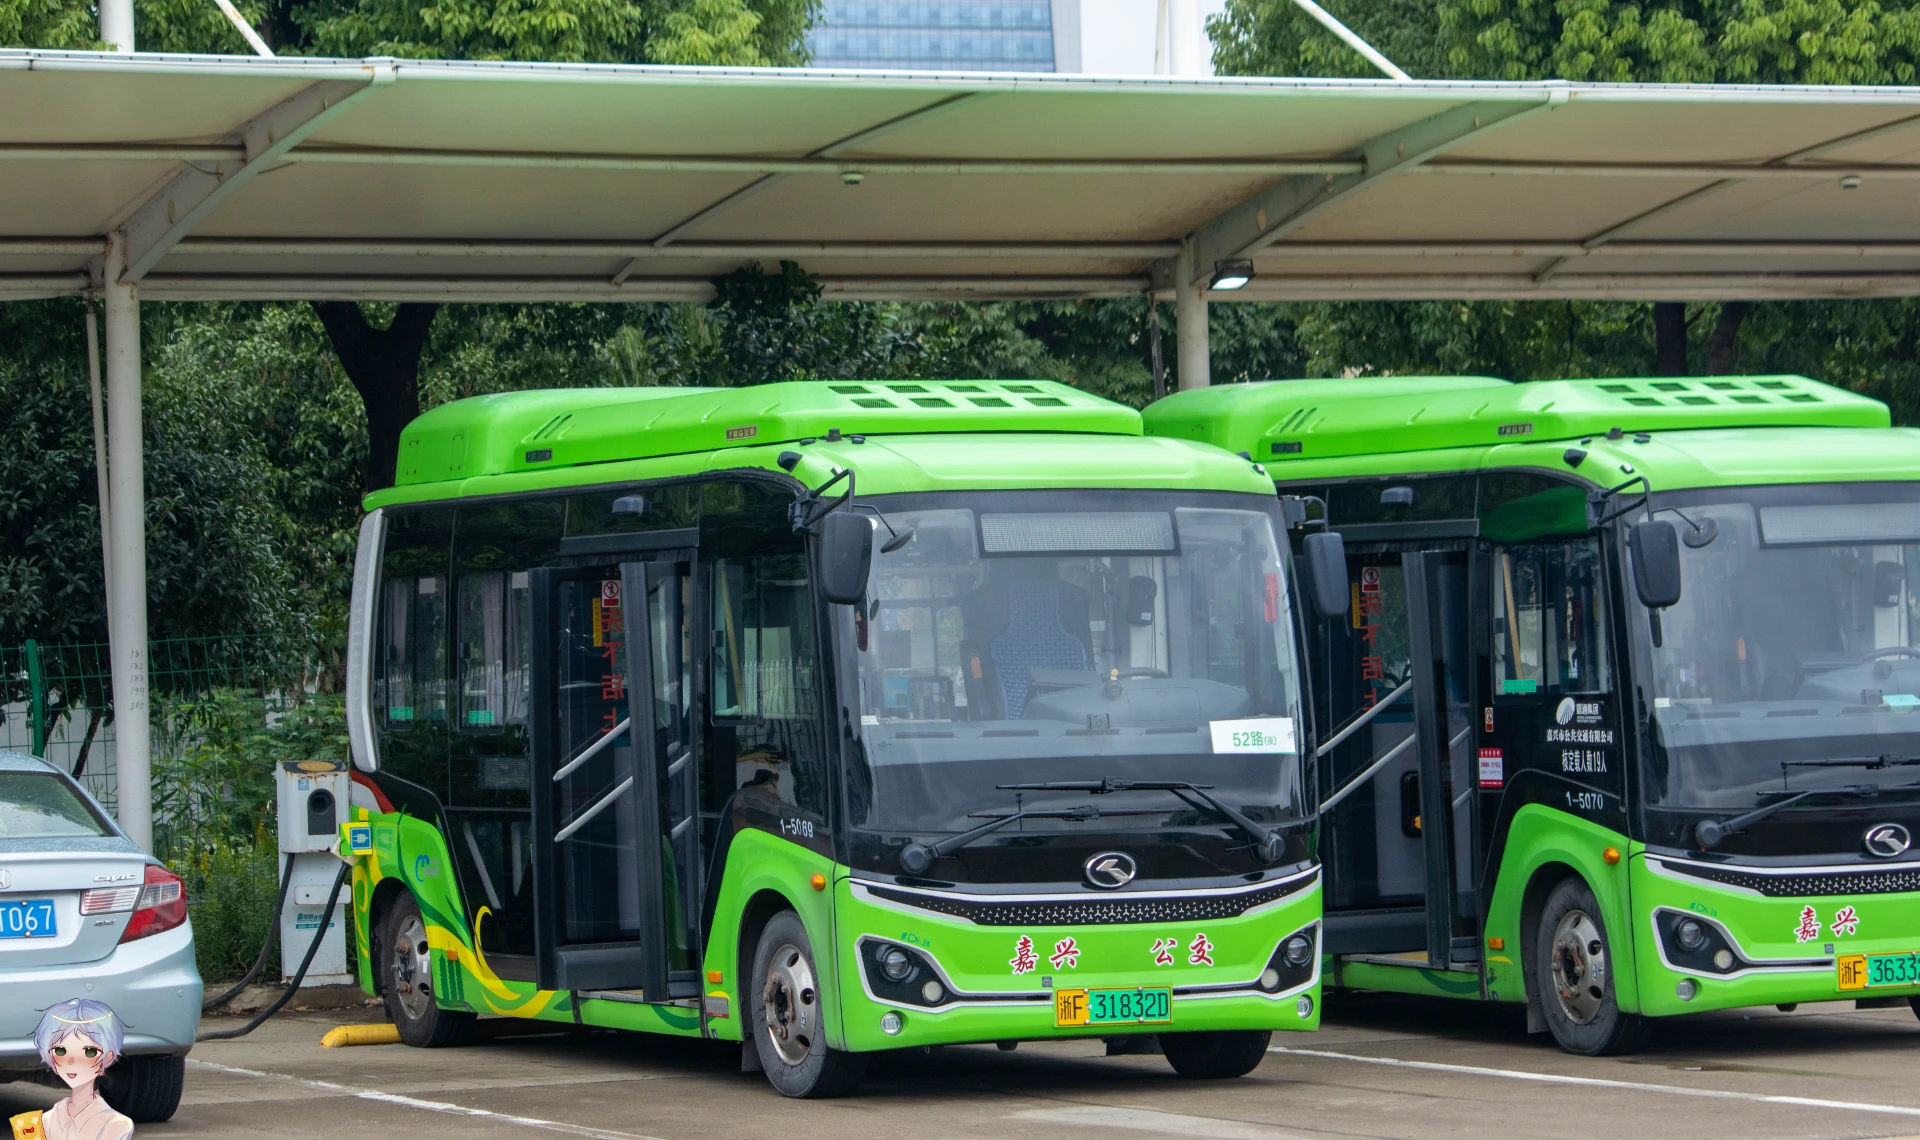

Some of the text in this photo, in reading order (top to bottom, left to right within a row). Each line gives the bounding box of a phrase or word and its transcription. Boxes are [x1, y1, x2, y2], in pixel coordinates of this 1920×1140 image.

[130, 649, 143, 660] 181
[130, 662, 143, 671] 182
[130, 674, 144, 684] 183
[1546, 728, 1613, 744] 嘉兴市公共交通有限公司
[1561, 749, 1607, 772] 核定载人数19人
[1565, 791, 1604, 809] 1-5070
[780, 818, 814, 838] 1-5069
[93, 873, 136, 882] CIVIC
[1795, 906, 1858, 942] 嘉兴
[1009, 934, 1213, 974] 嘉兴 公交
[1872, 957, 1920, 982] 3633
[1095, 992, 1169, 1019] 31832D
